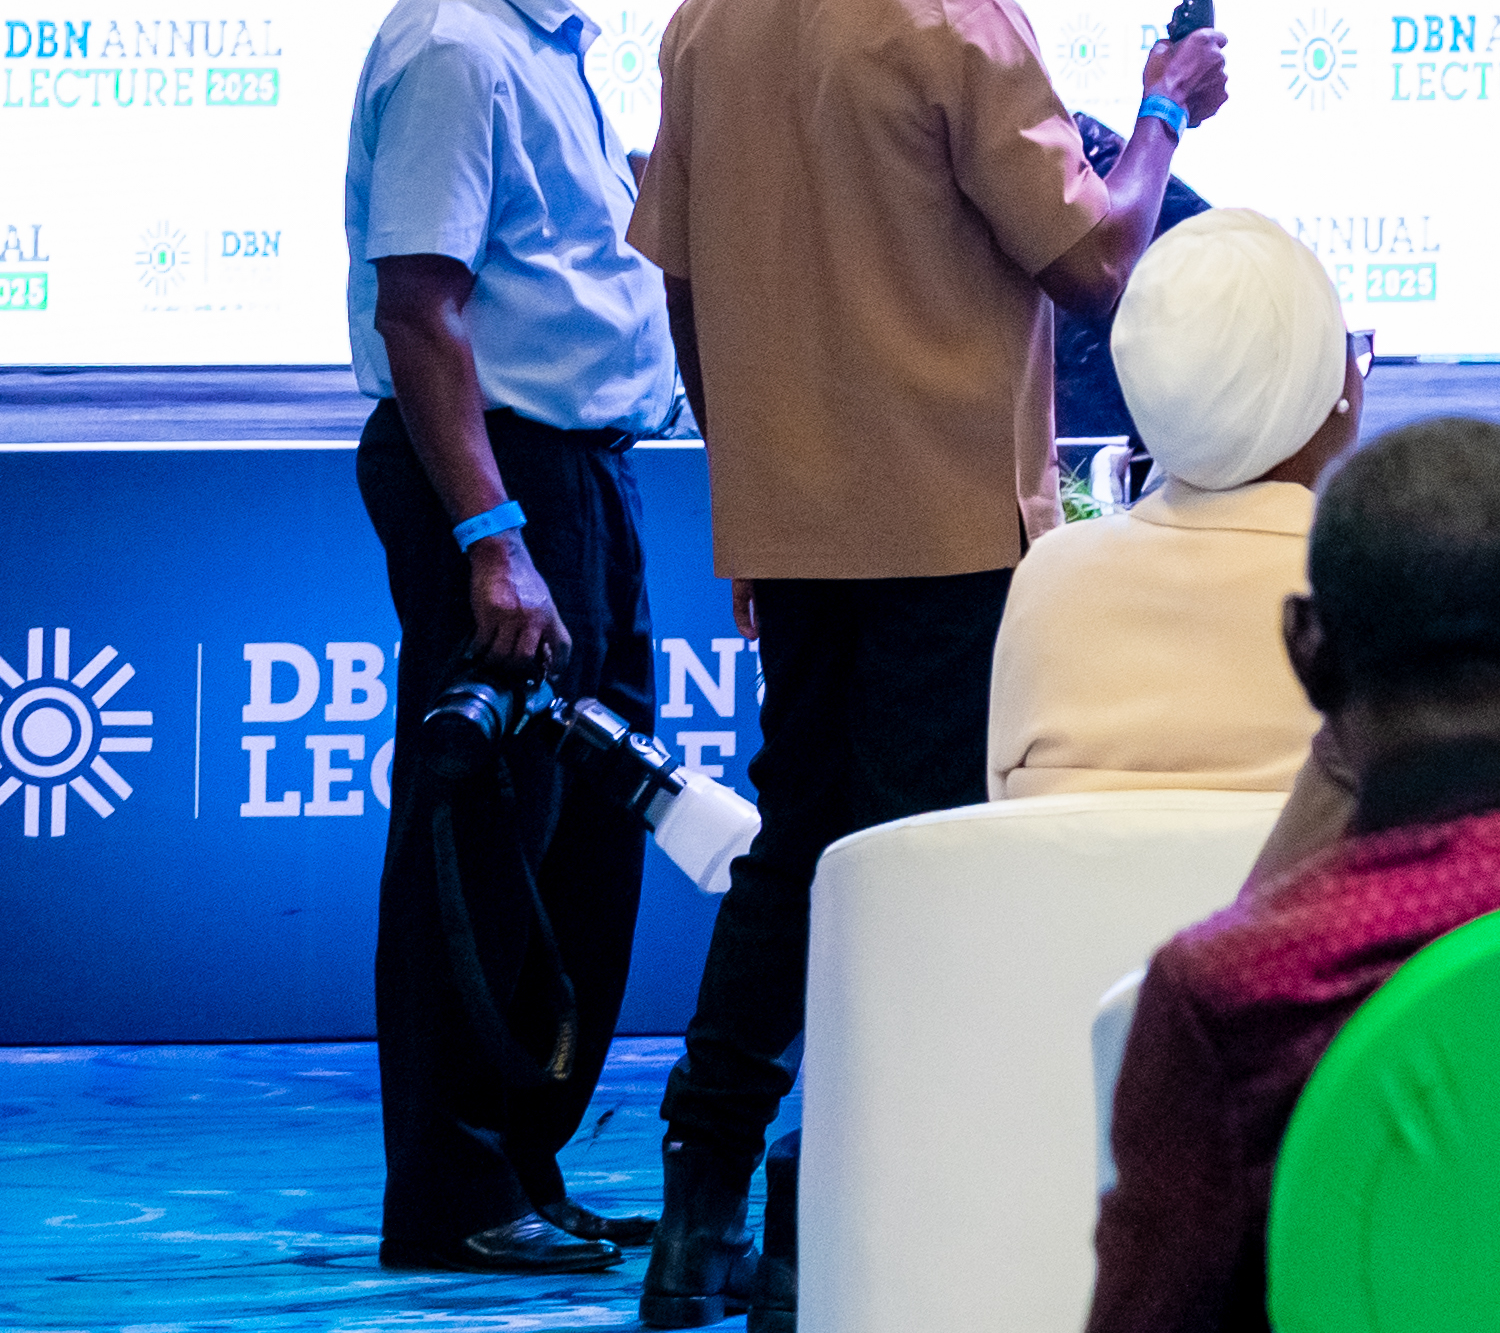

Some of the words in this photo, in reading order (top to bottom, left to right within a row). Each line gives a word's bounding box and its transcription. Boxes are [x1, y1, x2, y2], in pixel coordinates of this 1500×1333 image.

[4, 20, 92, 59] DBN
[101, 20, 282, 58] ANNUAL
[1391, 14, 1476, 54] DBN
[3, 68, 193, 108] LECTURE
[208, 73, 277, 102] 2025
[222, 231, 281, 257] DBN
[241, 641, 398, 724] DB
